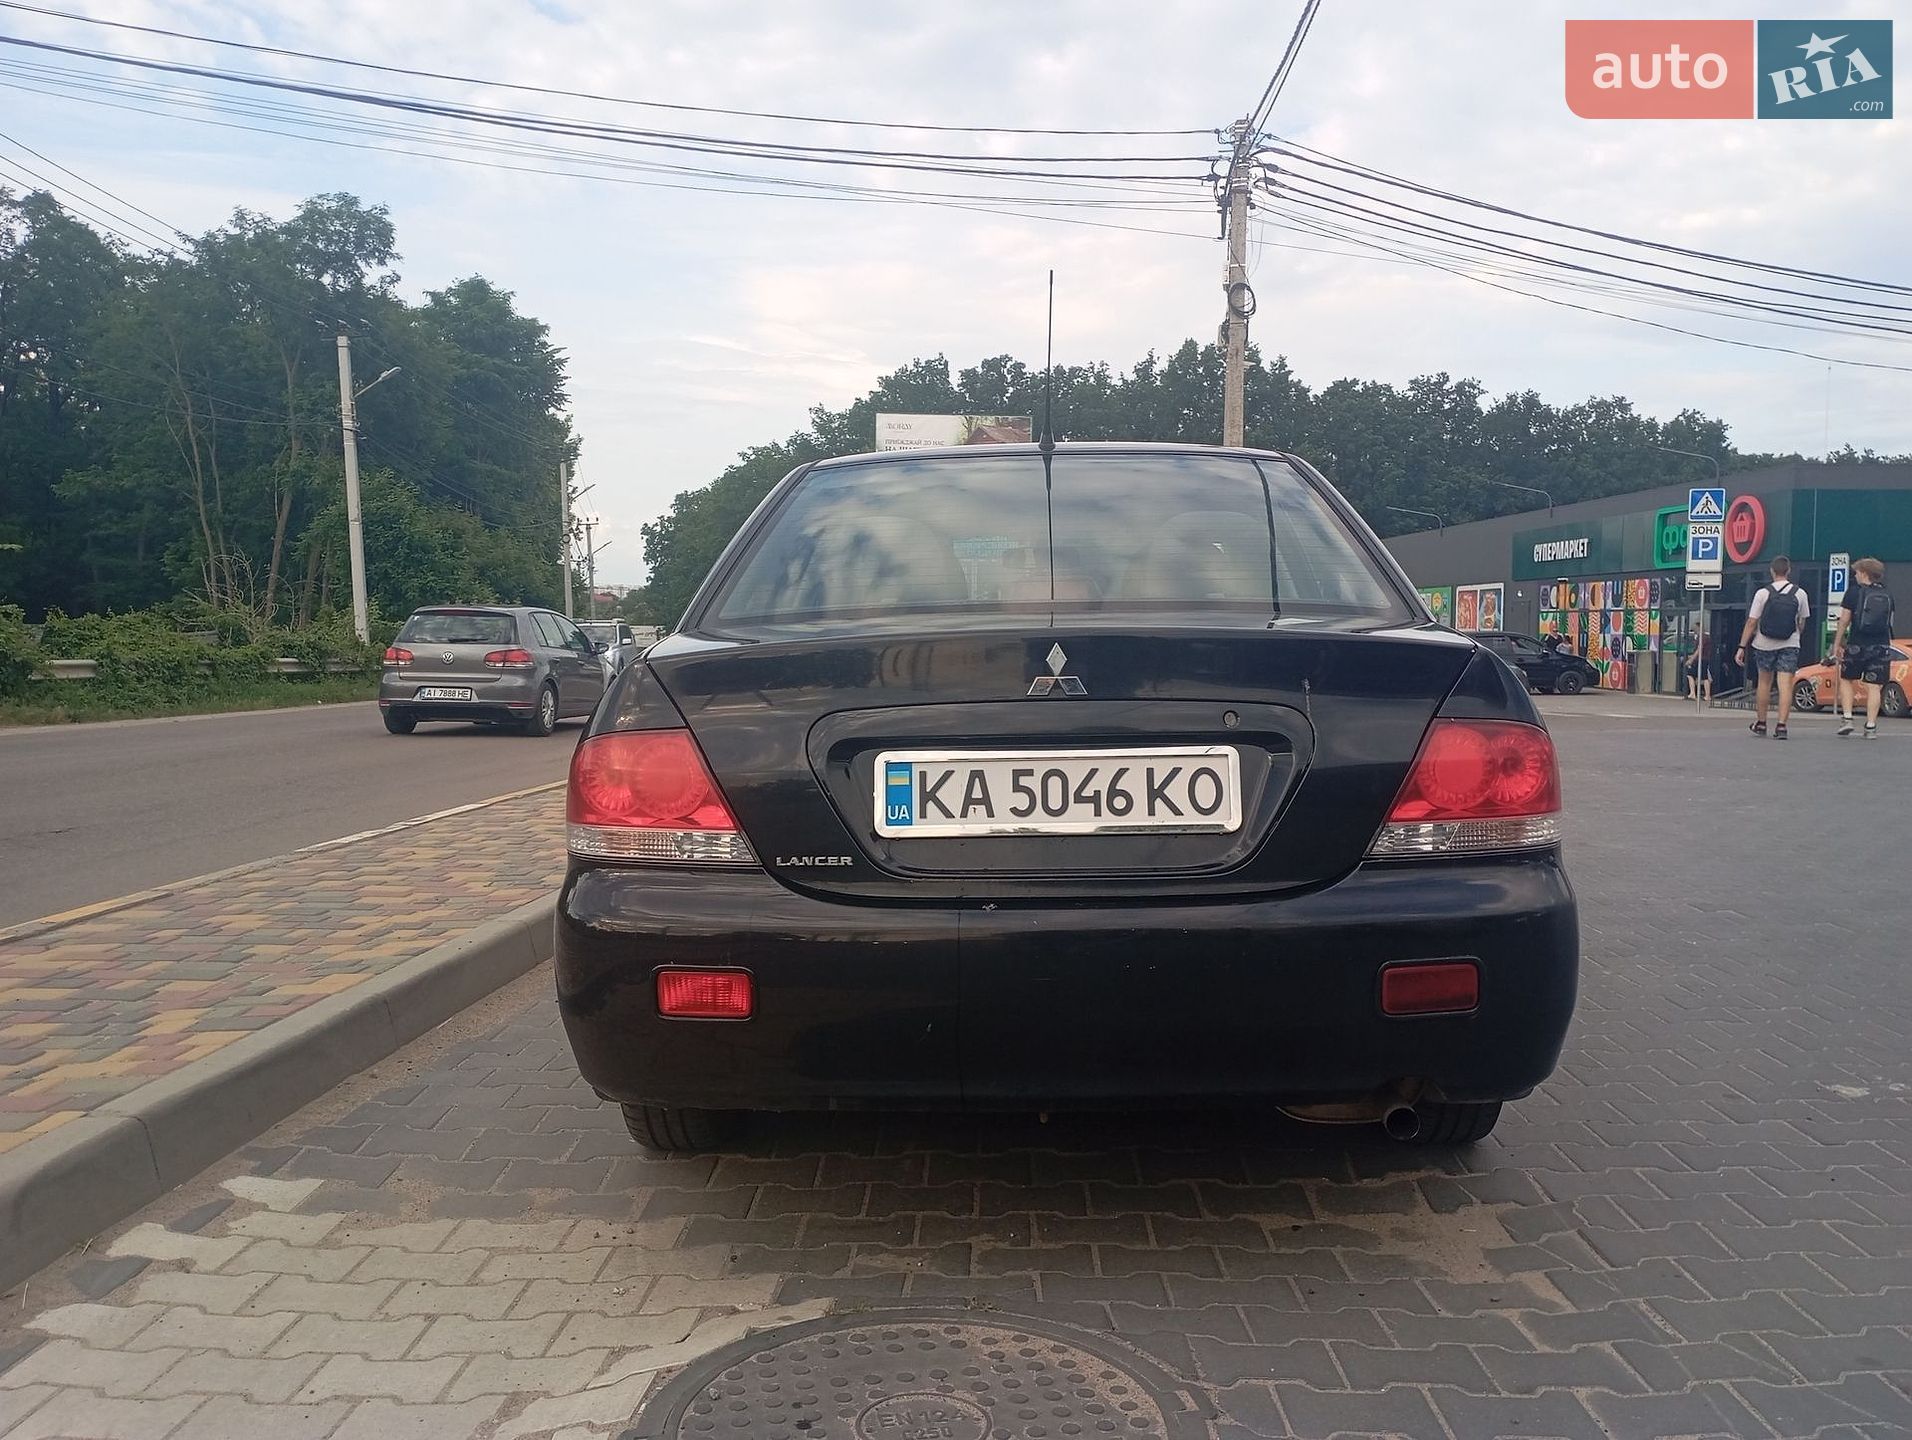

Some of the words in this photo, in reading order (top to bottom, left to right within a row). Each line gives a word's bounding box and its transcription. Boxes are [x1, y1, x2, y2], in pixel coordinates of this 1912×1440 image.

[1691, 526, 1720, 535] ЗОНА
[1533, 538, 1589, 563] СУПЕРМАРКЕТ
[1698, 538, 1714, 559] P
[1834, 570, 1843, 591] P
[918, 769, 996, 819] KA
[1009, 767, 1134, 818] 5046
[1146, 766, 1224, 817] KO
[888, 806, 910, 820] UA
[776, 856, 853, 866] LANCER
